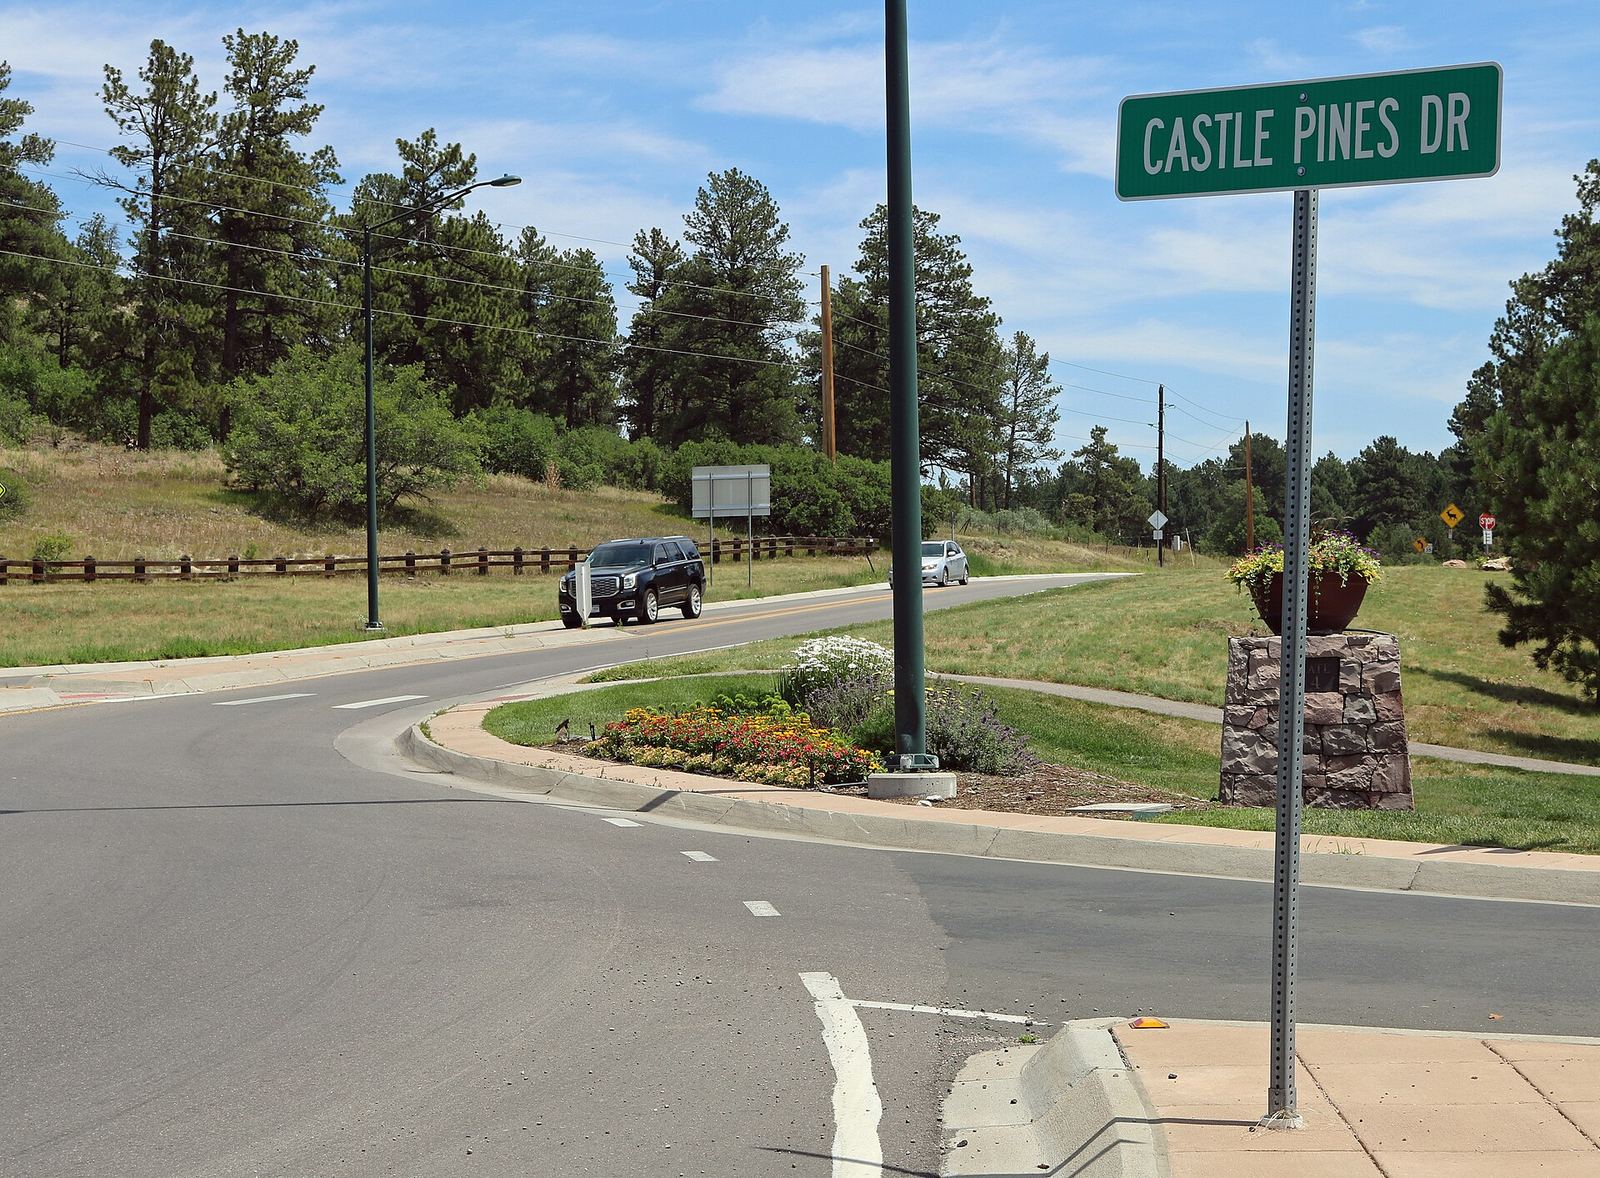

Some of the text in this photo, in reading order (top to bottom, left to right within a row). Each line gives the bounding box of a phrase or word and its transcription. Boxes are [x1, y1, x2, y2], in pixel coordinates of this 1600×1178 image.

[1143, 92, 1471, 175] CASTLE PINES DR
[1480, 517, 1495, 525] STOP
